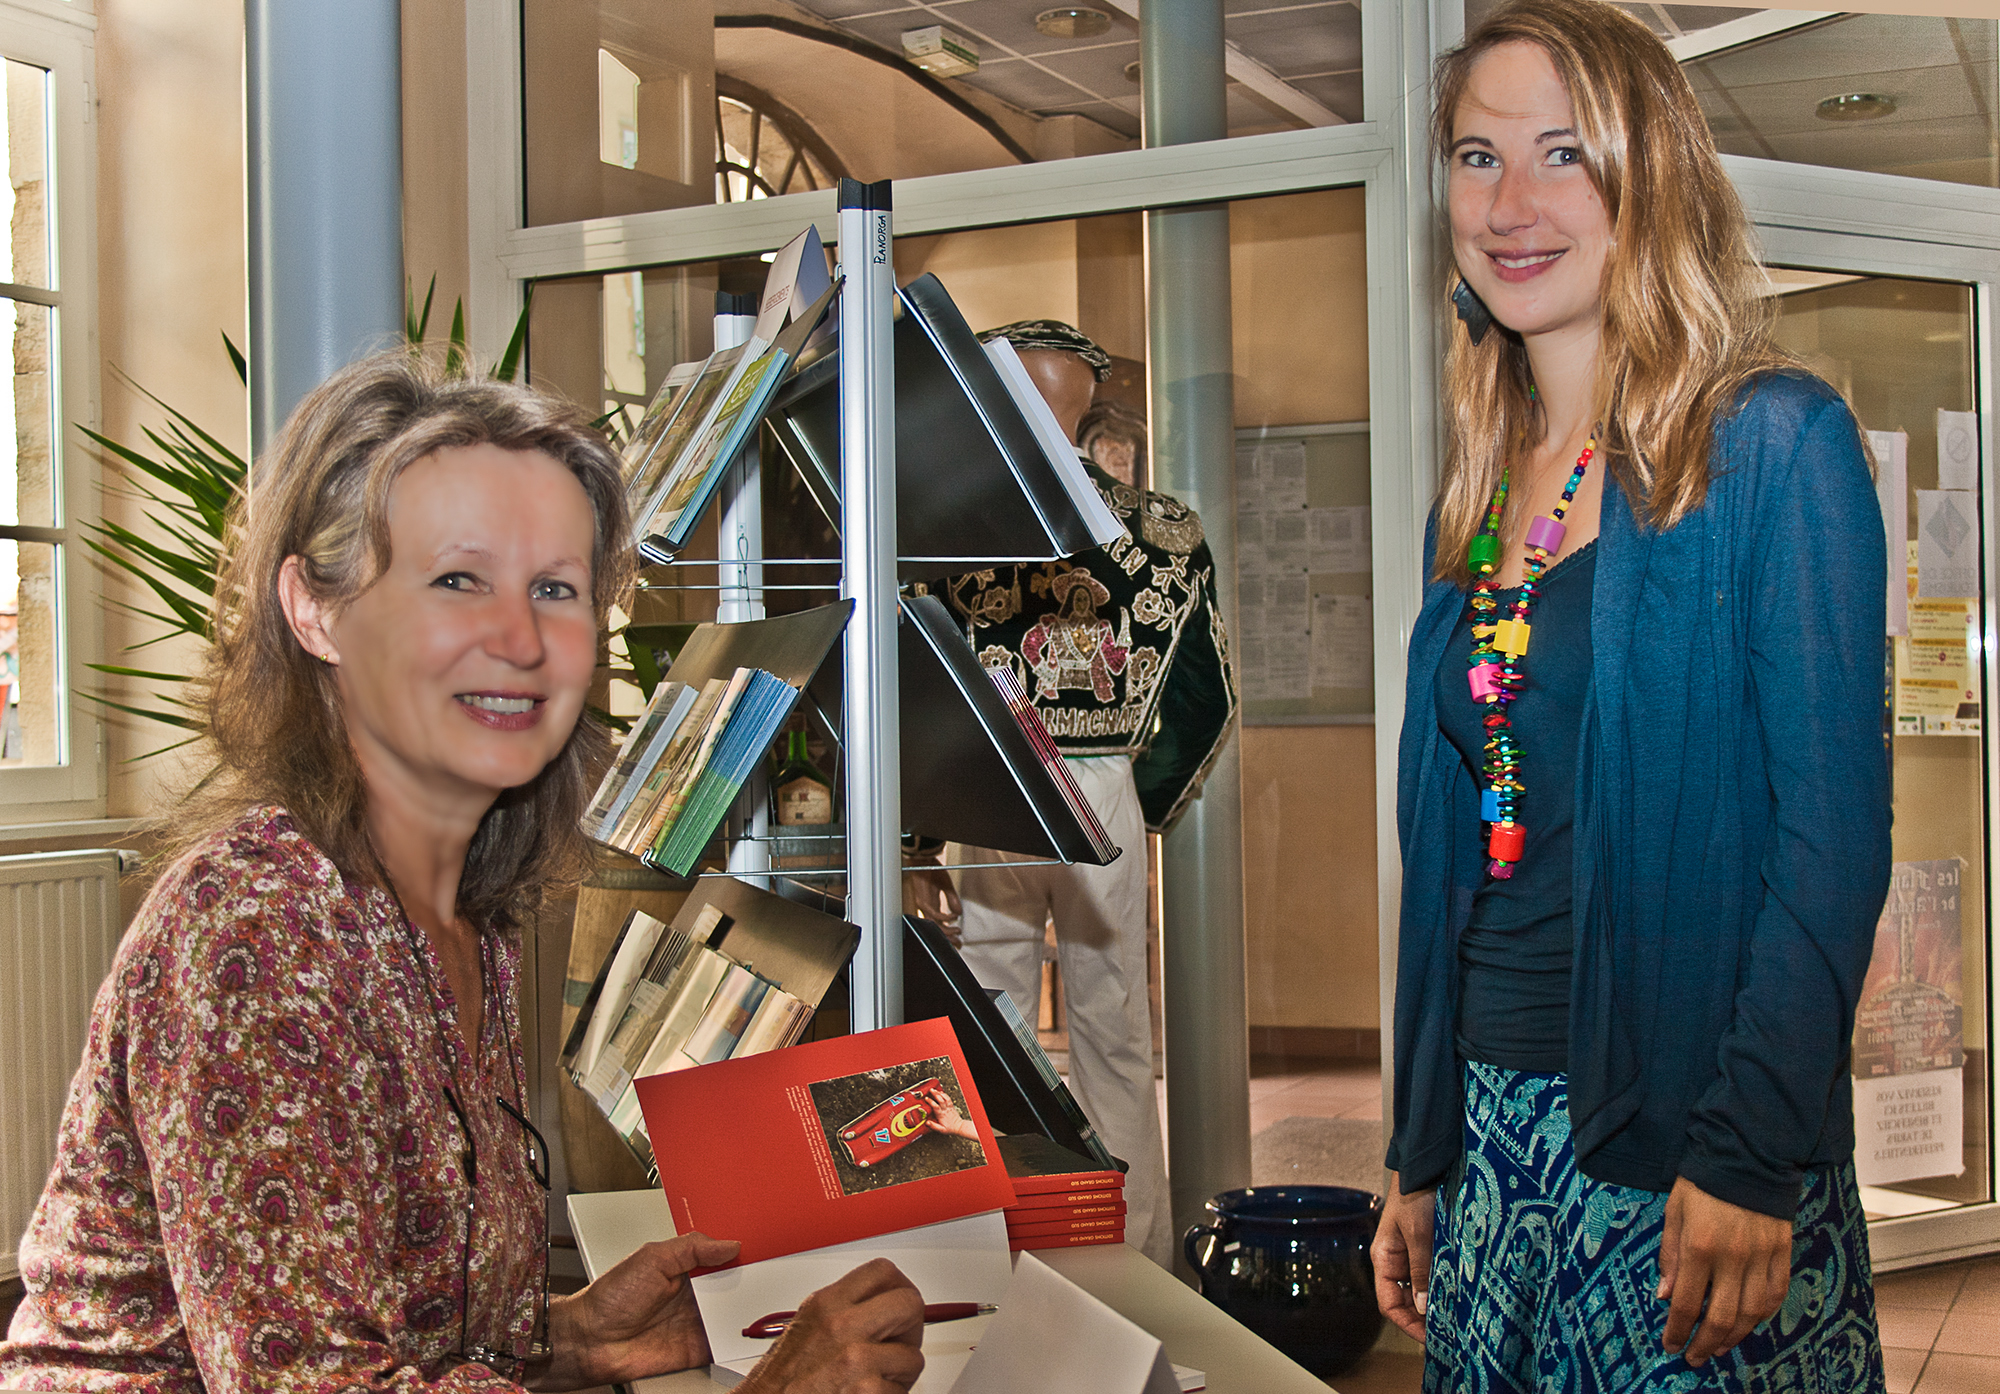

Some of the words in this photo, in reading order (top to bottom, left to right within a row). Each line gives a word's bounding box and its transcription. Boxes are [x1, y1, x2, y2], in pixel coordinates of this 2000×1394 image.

[873, 214, 887, 265] PLANORGA
[1033, 706, 1143, 738] RMAGNAC
[875, 1127, 891, 1143] 17
